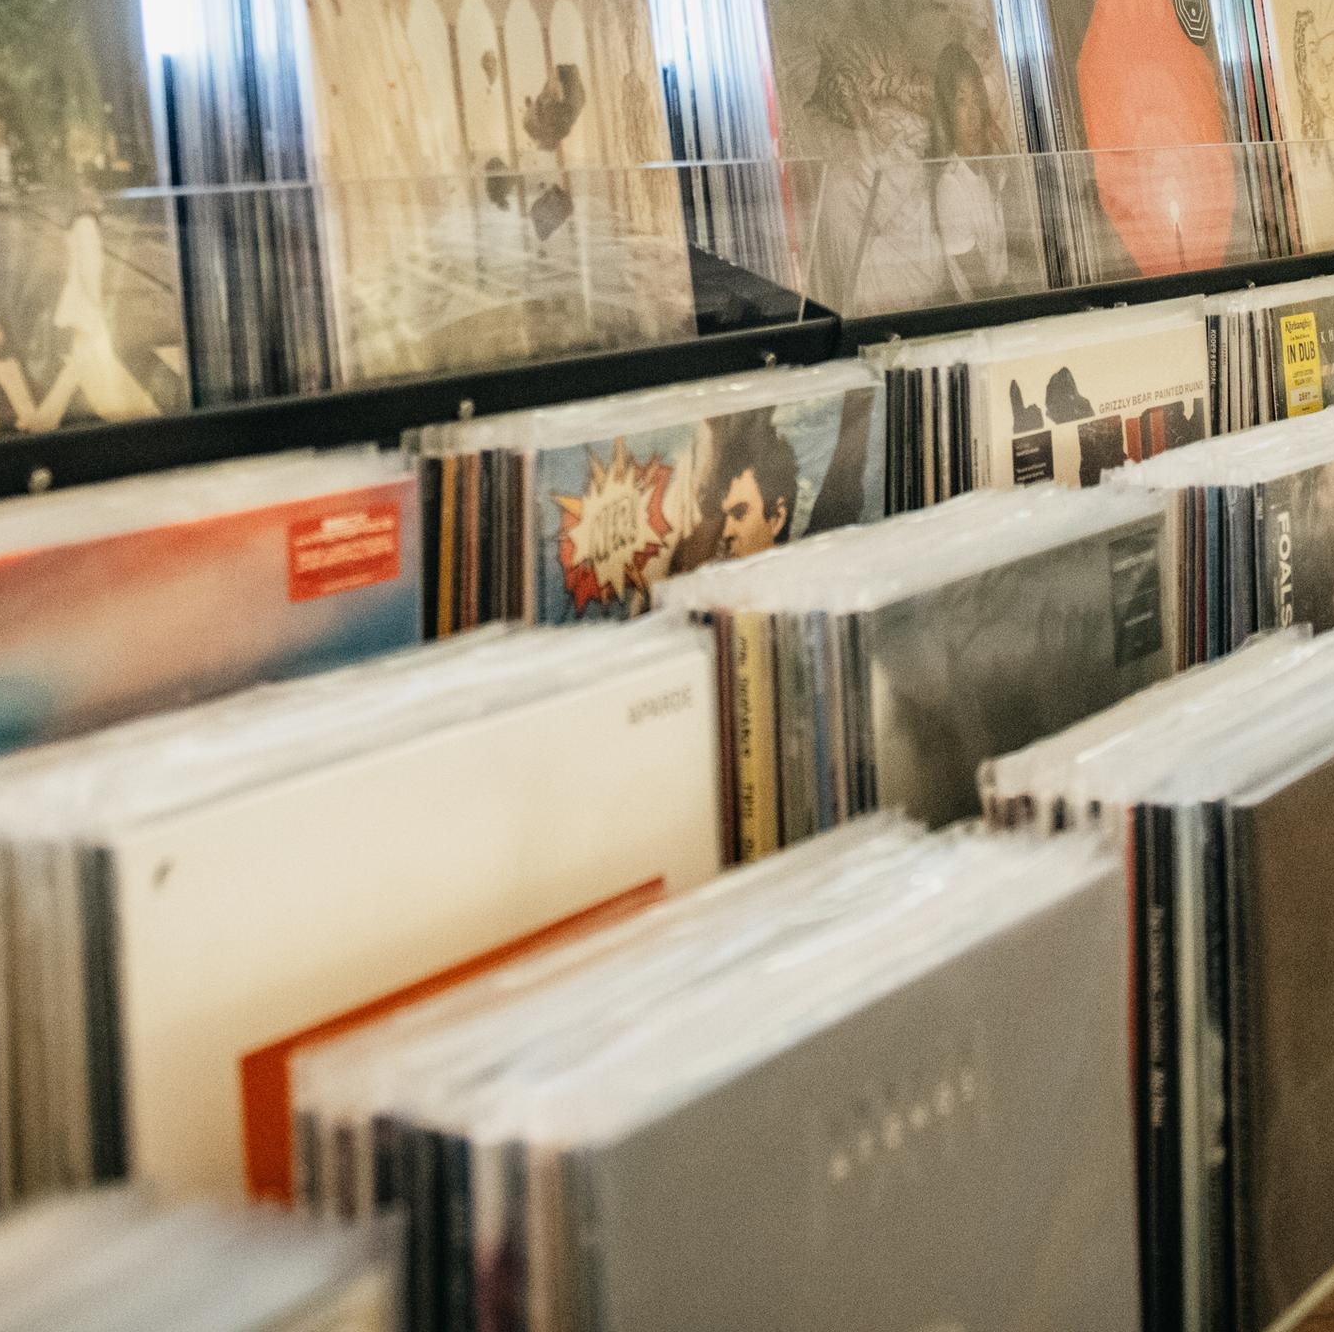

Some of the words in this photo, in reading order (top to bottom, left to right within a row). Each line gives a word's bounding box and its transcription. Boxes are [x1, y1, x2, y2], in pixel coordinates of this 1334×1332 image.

[1286, 344, 1297, 365] IN
[1298, 340, 1316, 362] DUB
[1098, 395, 1133, 414] GRIZZLY
[1132, 392, 1153, 406] BEAR
[1154, 383, 1186, 401] PAINTED
[1184, 379, 1204, 395] RUINS
[1277, 511, 1293, 629] FOALS
